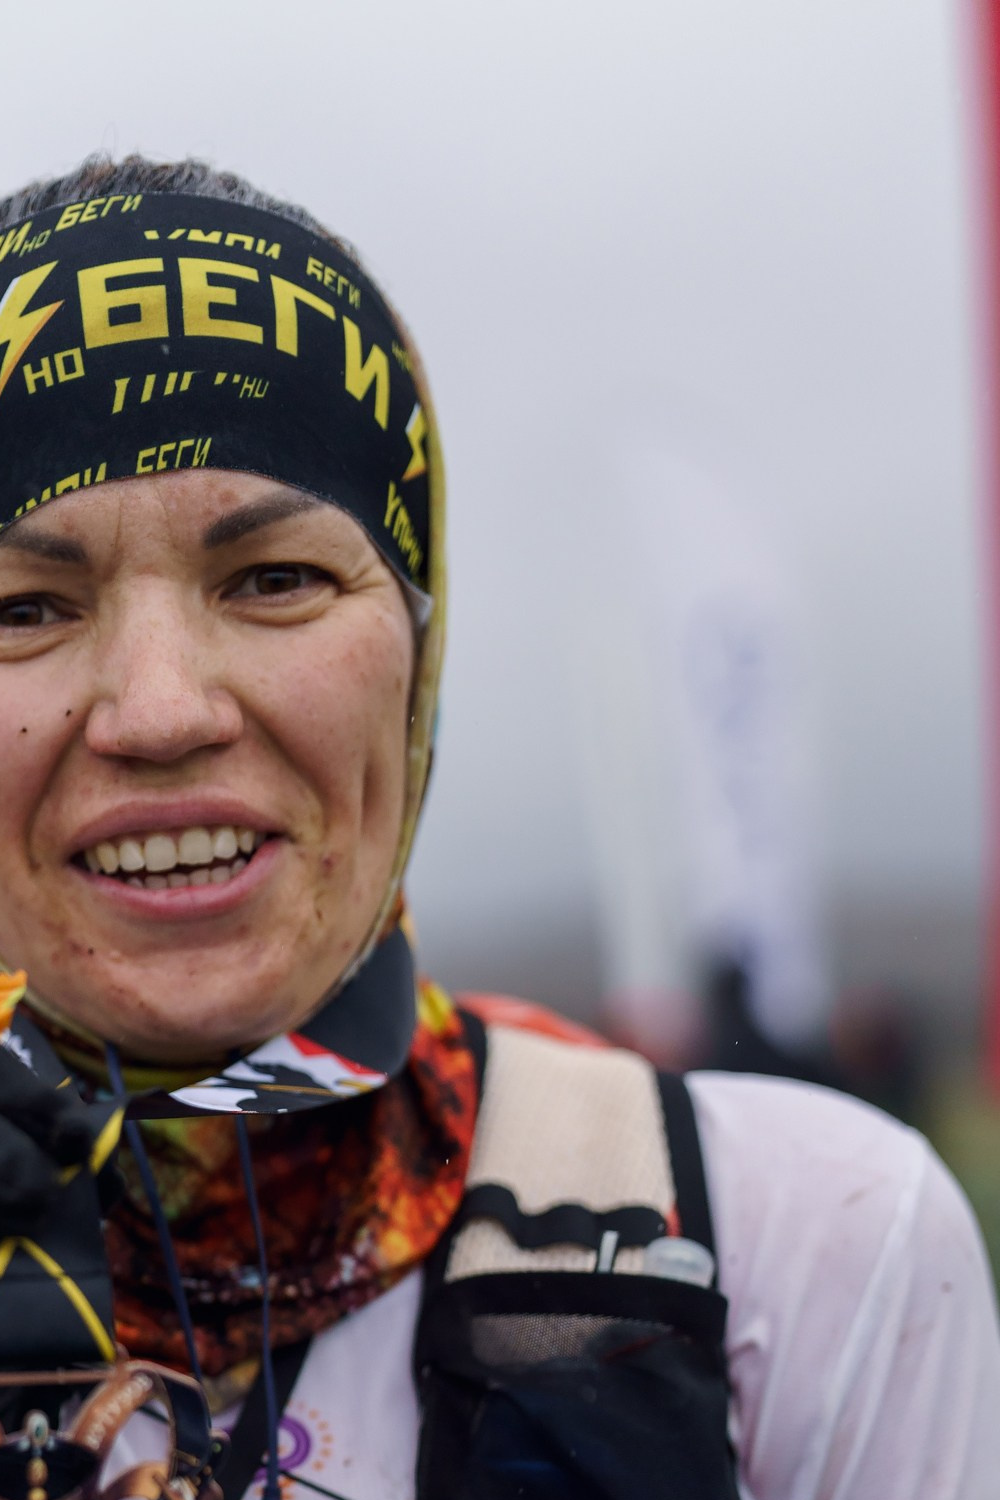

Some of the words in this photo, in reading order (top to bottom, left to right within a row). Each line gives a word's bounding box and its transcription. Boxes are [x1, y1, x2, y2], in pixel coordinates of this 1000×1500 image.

[55, 194, 143, 233] БЕГИ
[22, 347, 86, 395] НО
[77, 257, 390, 431] БЕГИ
